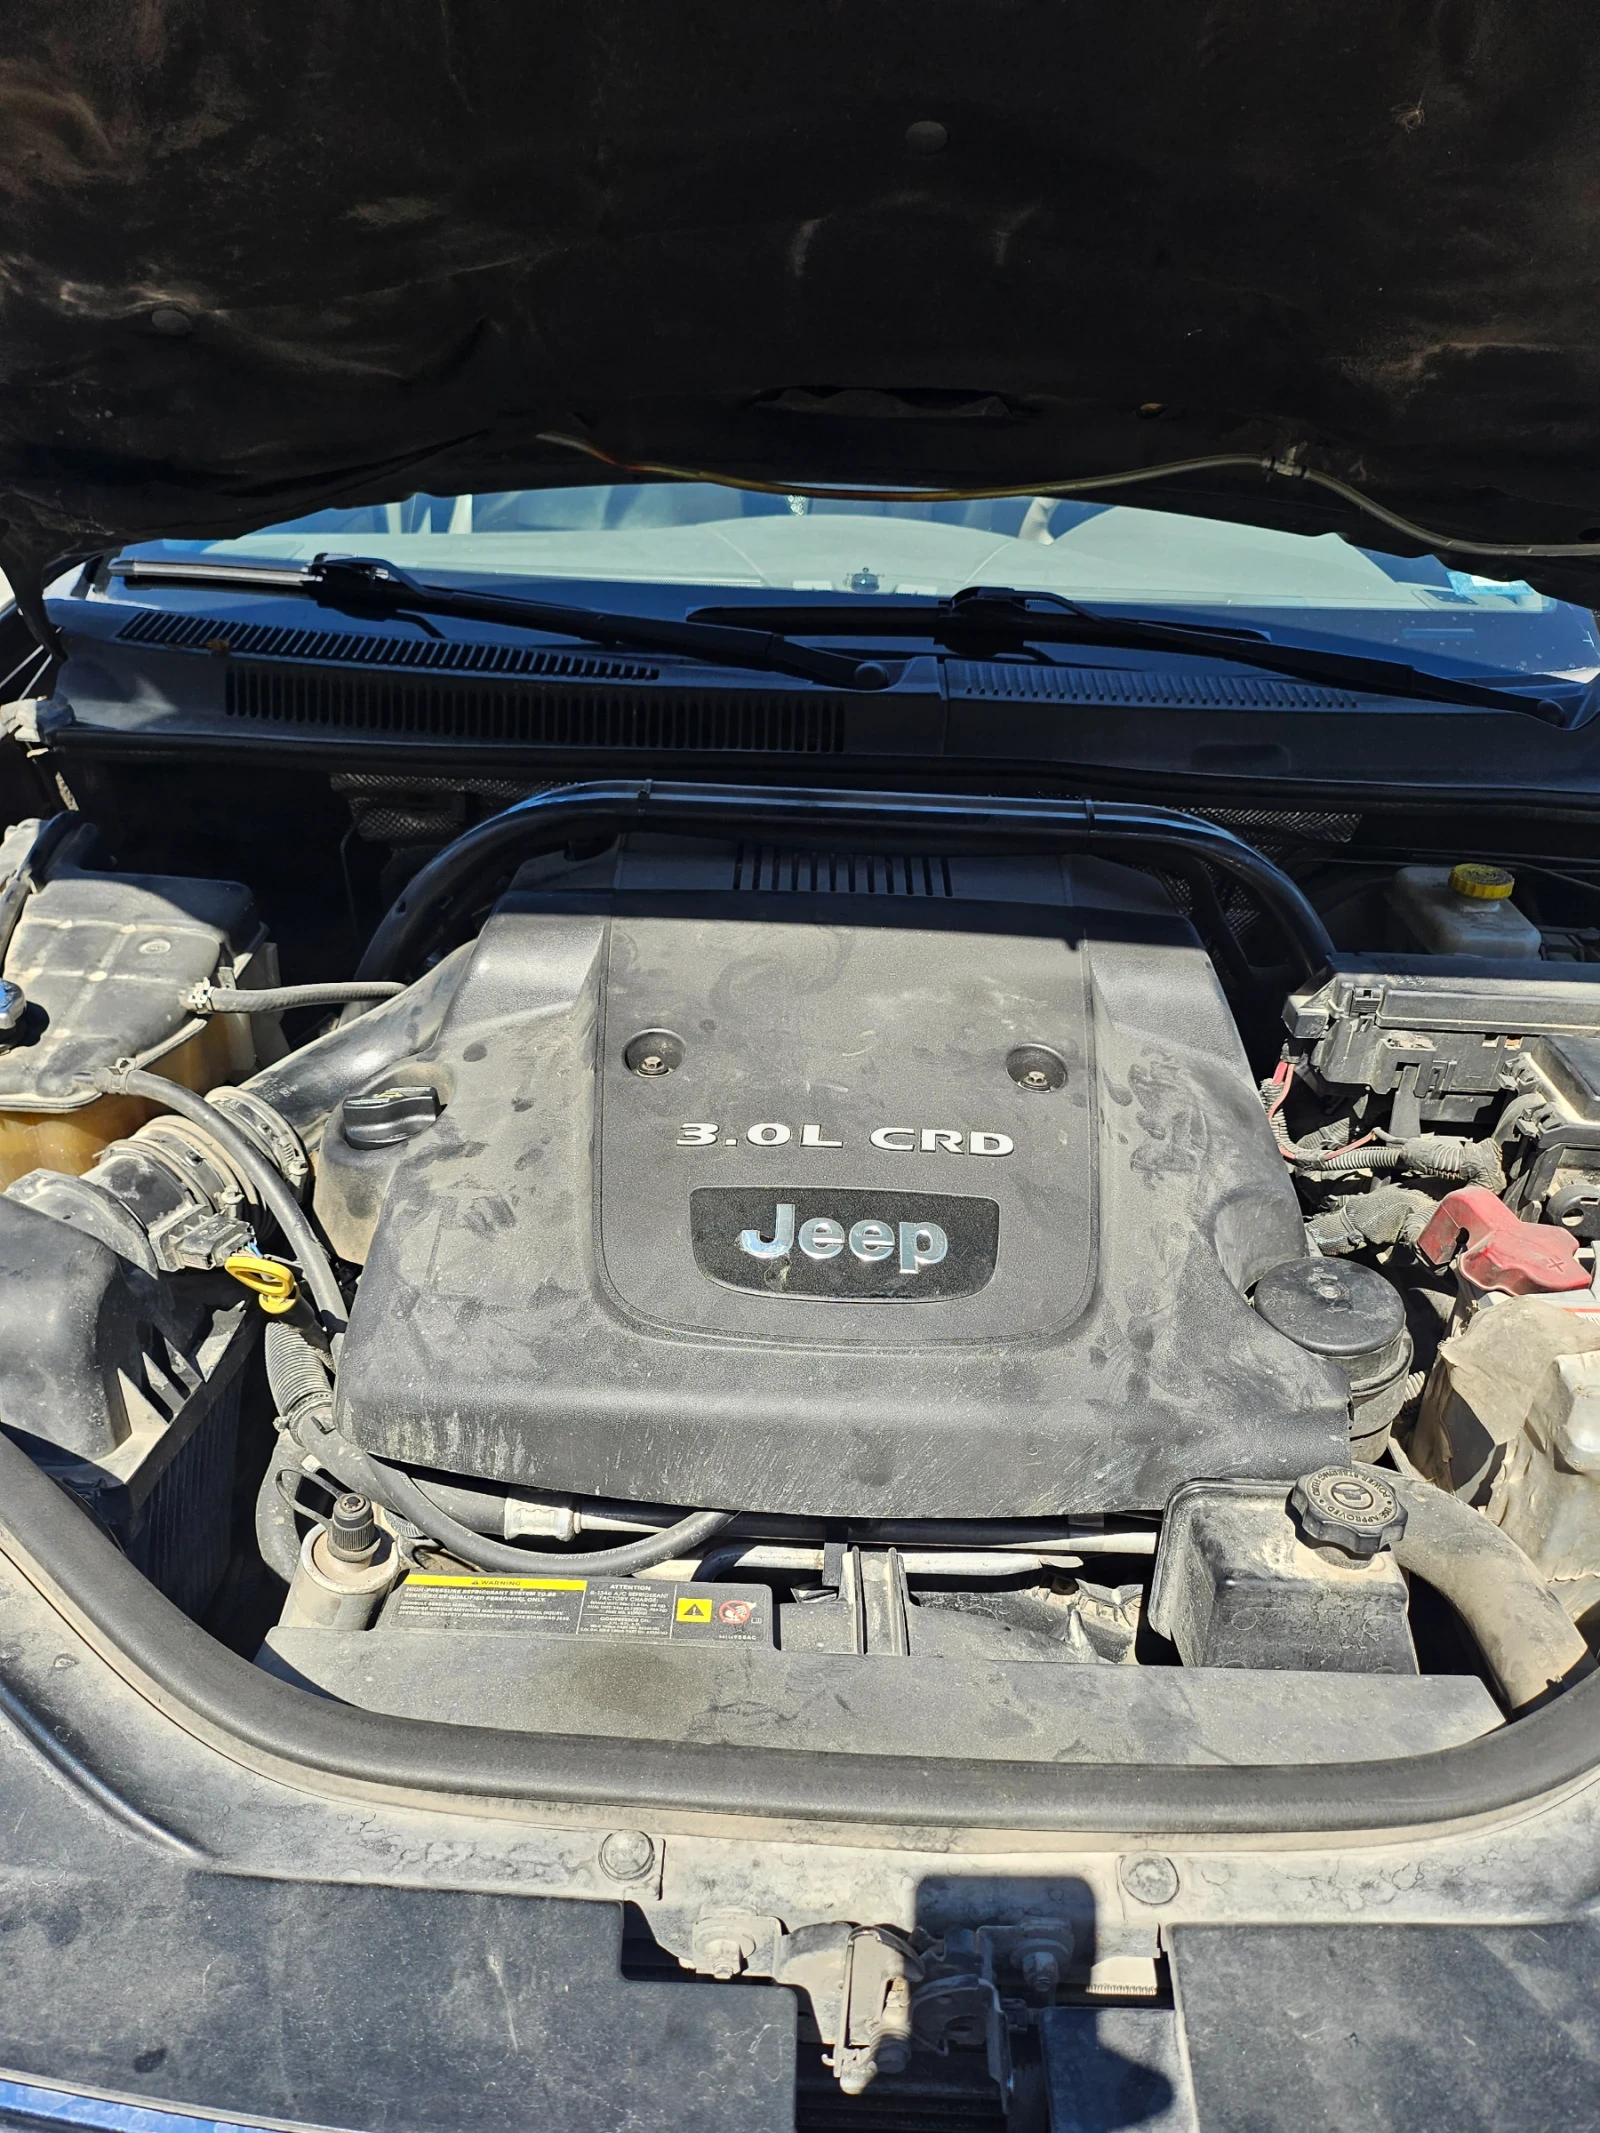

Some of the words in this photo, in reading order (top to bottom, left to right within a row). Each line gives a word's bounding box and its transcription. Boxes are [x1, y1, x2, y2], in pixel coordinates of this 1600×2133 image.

[676, 1122, 844, 1147] 3.0L
[869, 1126, 1015, 1157] CRD
[739, 1203, 949, 1274] Jeep
[1362, 1475, 1391, 1498] POWER
[1327, 1506, 1380, 1523] APPROVED
[406, 1586, 462, 1594] HIGH-PRESSURE
